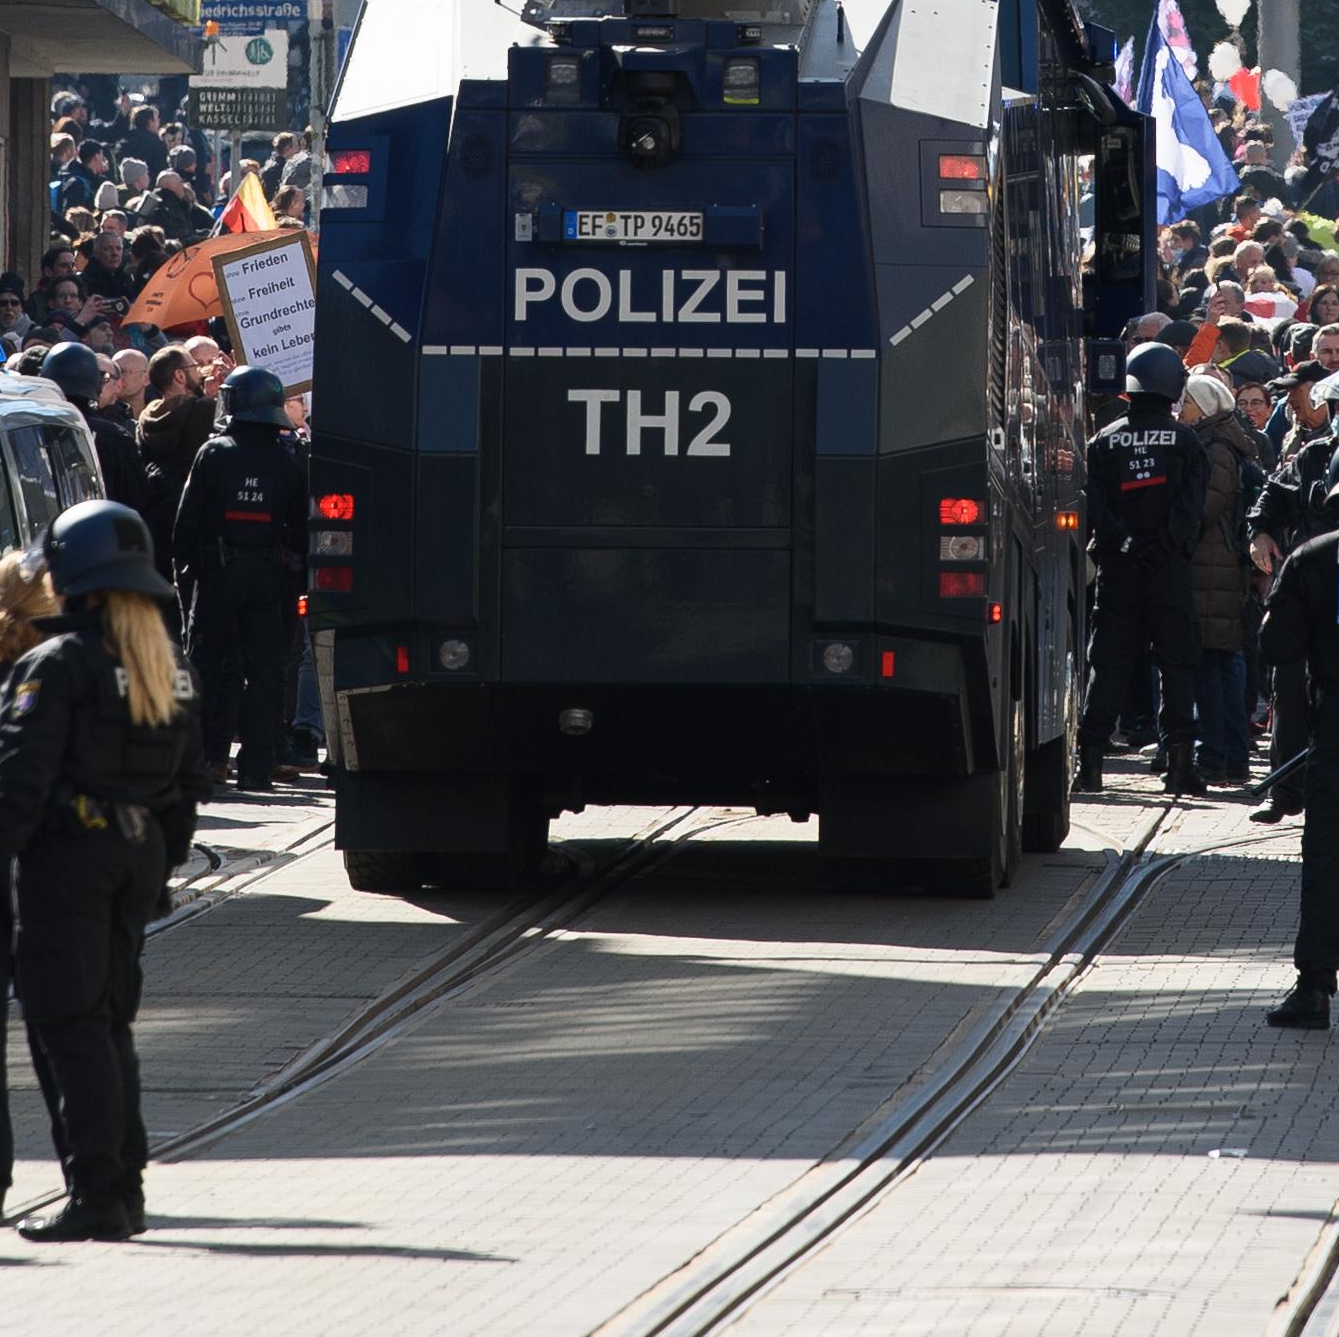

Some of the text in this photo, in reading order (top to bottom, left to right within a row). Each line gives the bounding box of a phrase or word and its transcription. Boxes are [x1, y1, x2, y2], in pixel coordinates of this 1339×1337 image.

[202, 3, 301, 17] iedrichsstraße
[199, 92, 236, 101] GRIMM
[199, 103, 225, 113] WELT
[578, 215, 604, 236] EF
[620, 215, 645, 236] TP
[651, 215, 701, 236] 9465
[242, 253, 288, 274] Frieden
[249, 277, 295, 300] Freiheit
[515, 268, 786, 323] POLIZEI
[240, 298, 315, 329] Grundrechte
[253, 345, 279, 359] kein
[568, 389, 732, 456] TH2
[1109, 431, 1176, 449] POLIZEI
[1143, 458, 1155, 467] 23
[245, 478, 258, 487] HE
